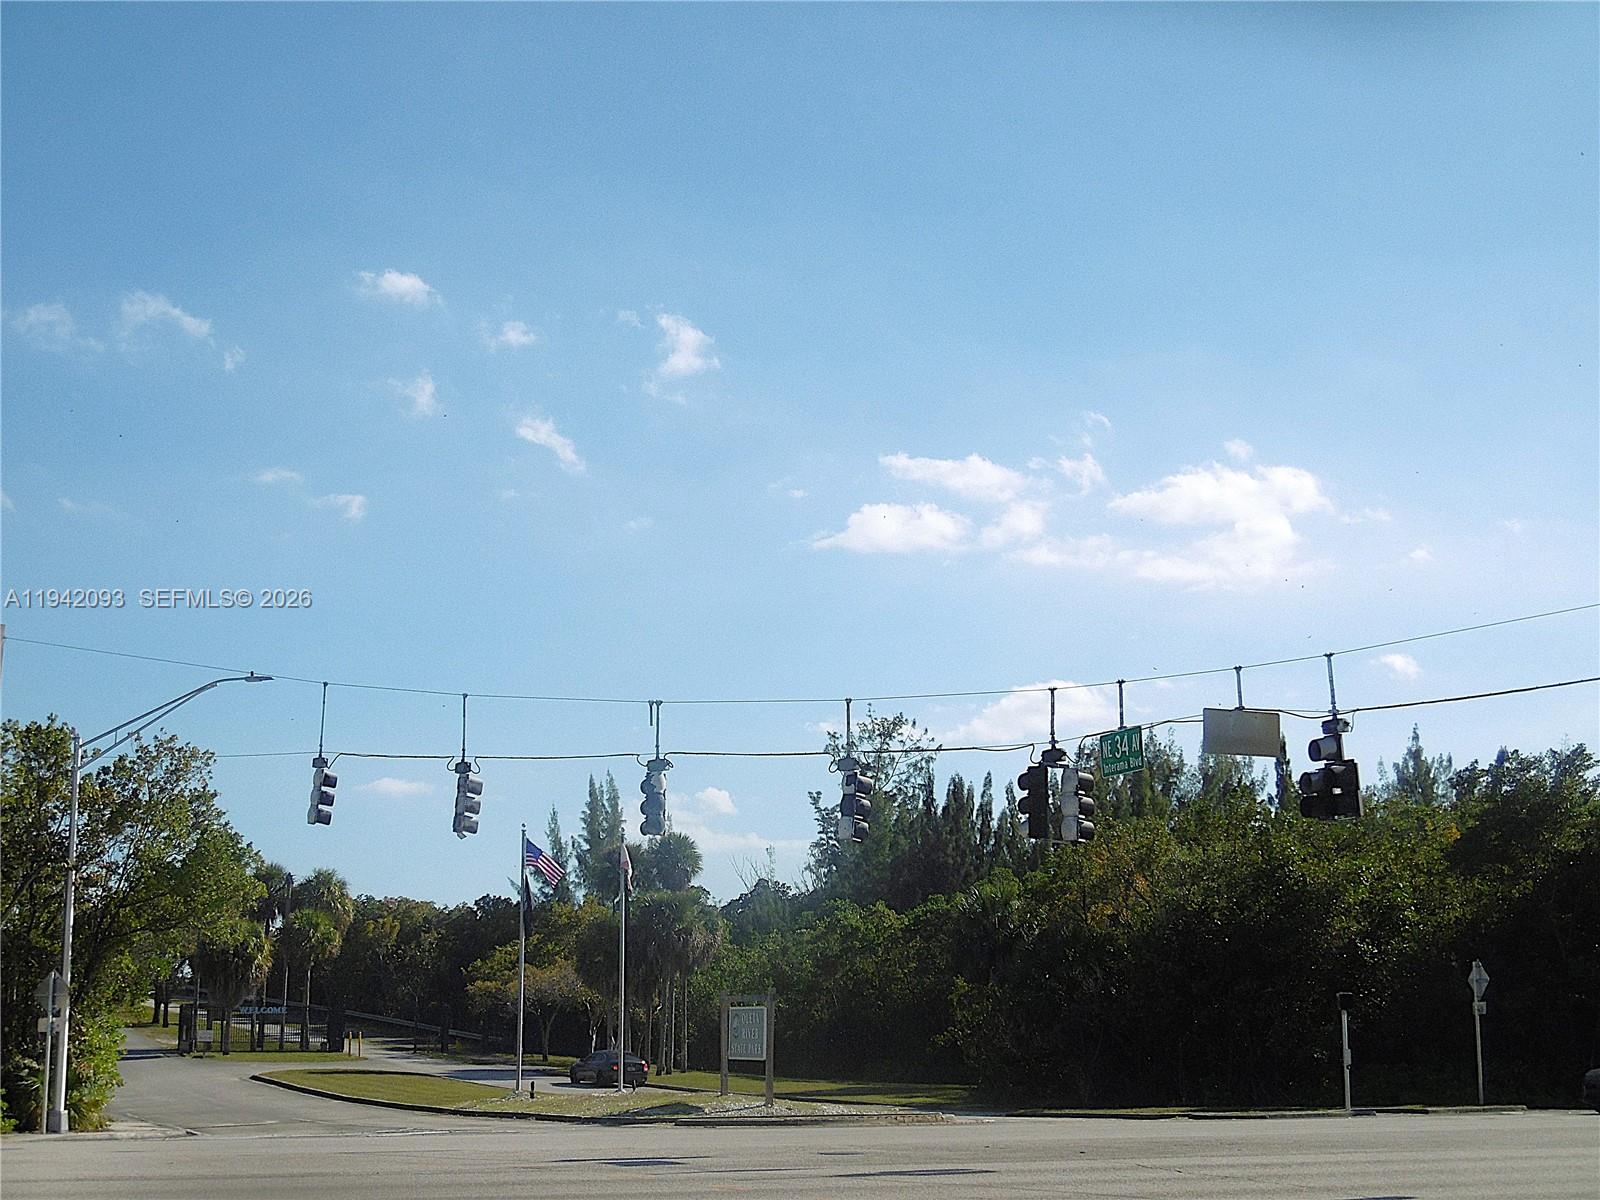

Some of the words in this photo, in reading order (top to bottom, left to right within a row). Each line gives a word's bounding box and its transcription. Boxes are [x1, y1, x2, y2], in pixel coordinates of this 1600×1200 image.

[1103, 741, 1112, 758] NE
[1115, 733, 1129, 758] 34
[1132, 733, 1140, 751] AV
[1130, 756, 1142, 768] Blvd
[240, 1006, 288, 1015] WELCOME
[742, 1028, 760, 1040] RIVER
